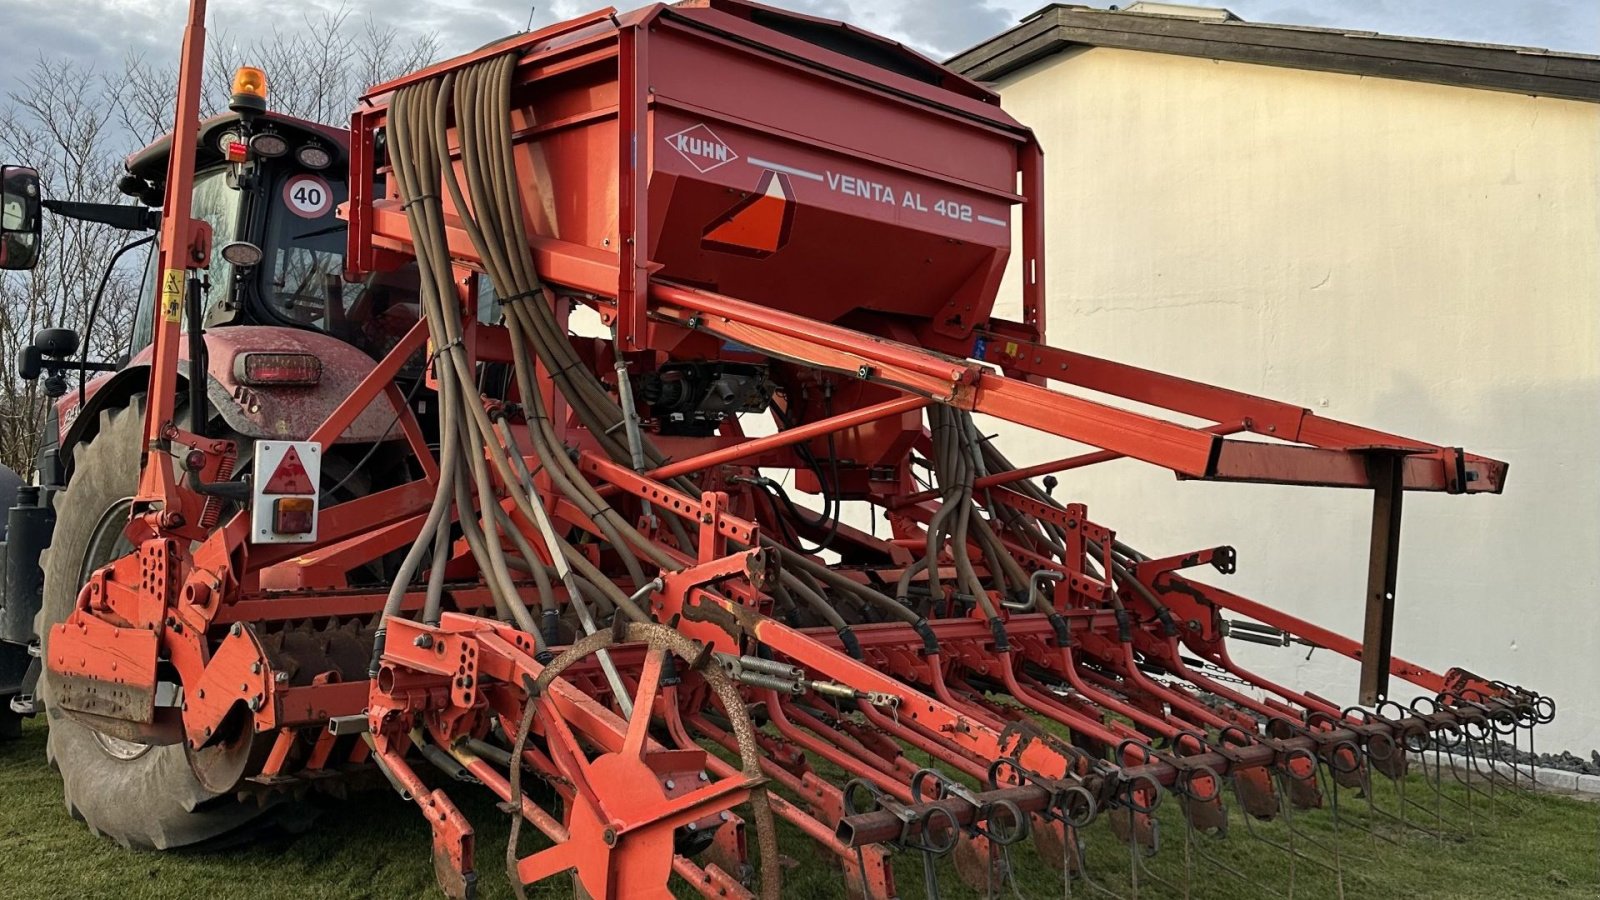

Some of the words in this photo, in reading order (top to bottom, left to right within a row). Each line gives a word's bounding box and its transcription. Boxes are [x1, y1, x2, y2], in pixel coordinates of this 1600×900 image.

[677, 134, 728, 162] KUHN
[293, 187, 321, 206] 40
[826, 170, 896, 205] VENTA
[902, 191, 928, 212] AL
[934, 200, 972, 223] 402
